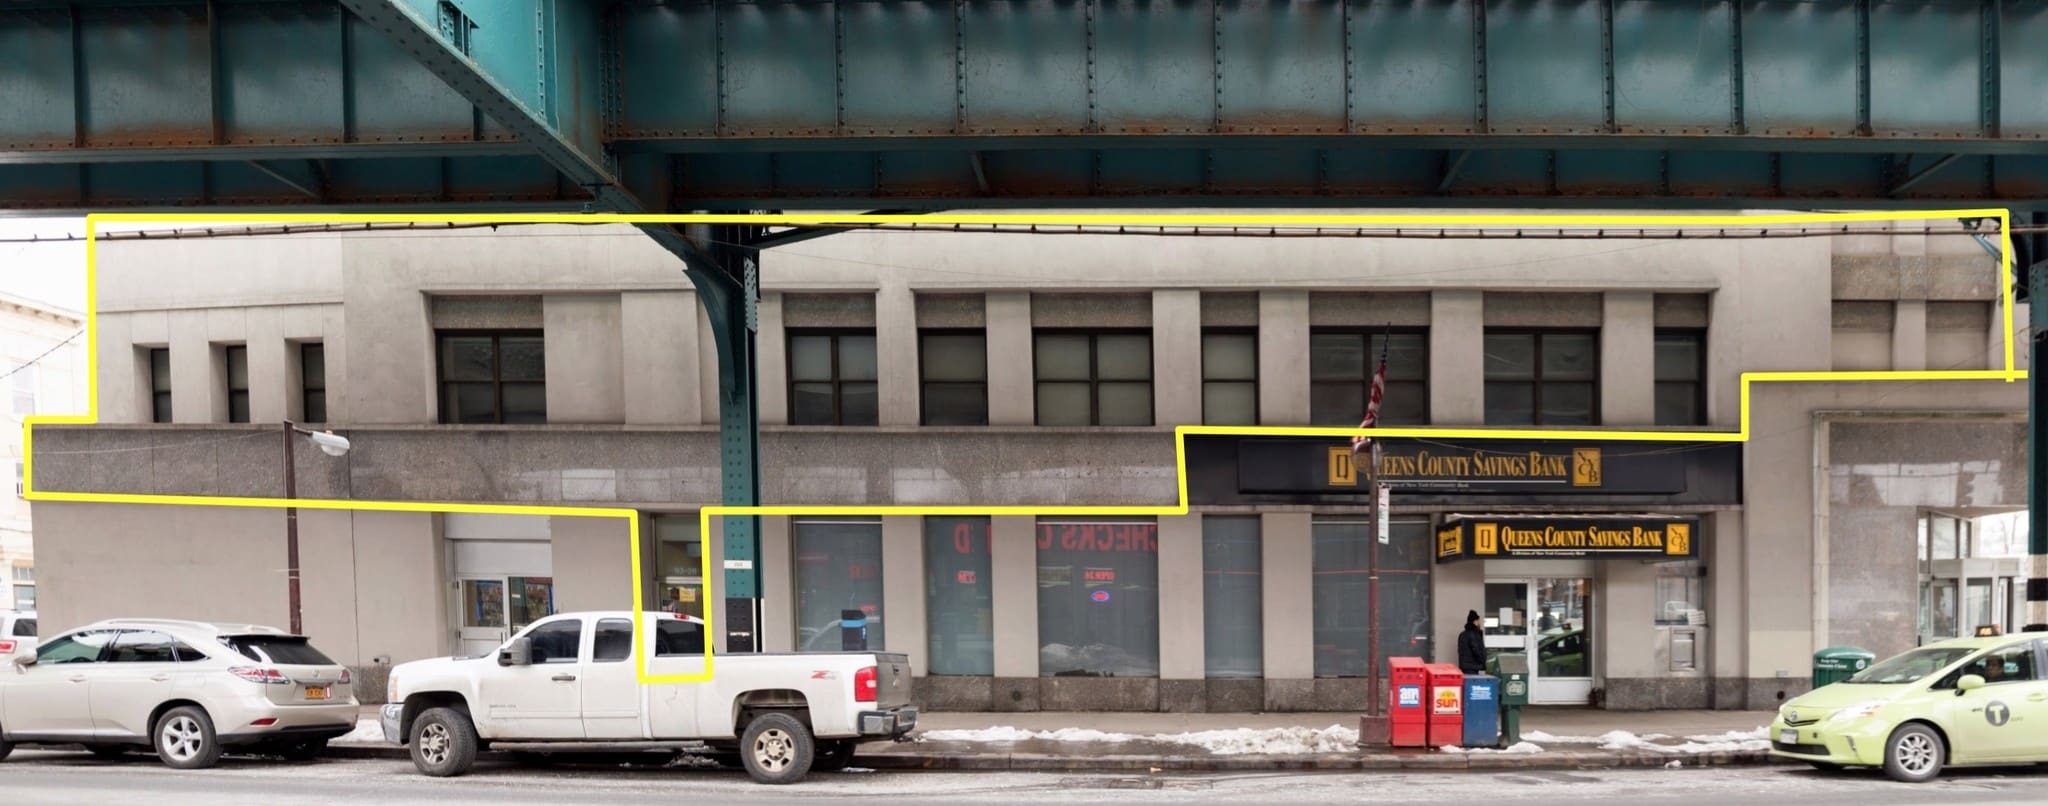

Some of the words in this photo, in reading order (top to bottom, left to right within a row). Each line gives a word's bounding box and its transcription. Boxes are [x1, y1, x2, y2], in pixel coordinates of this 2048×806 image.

[1366, 452, 1415, 481] EENS
[1417, 450, 1472, 477] COUNTY
[1474, 451, 1527, 478] SAVINGS
[1529, 452, 1568, 478] BANK
[1501, 525, 1544, 551] QUEENS
[1544, 526, 1587, 547] COUNTY
[1588, 526, 1631, 547] SAVINGS
[1632, 526, 1663, 547] BANK
